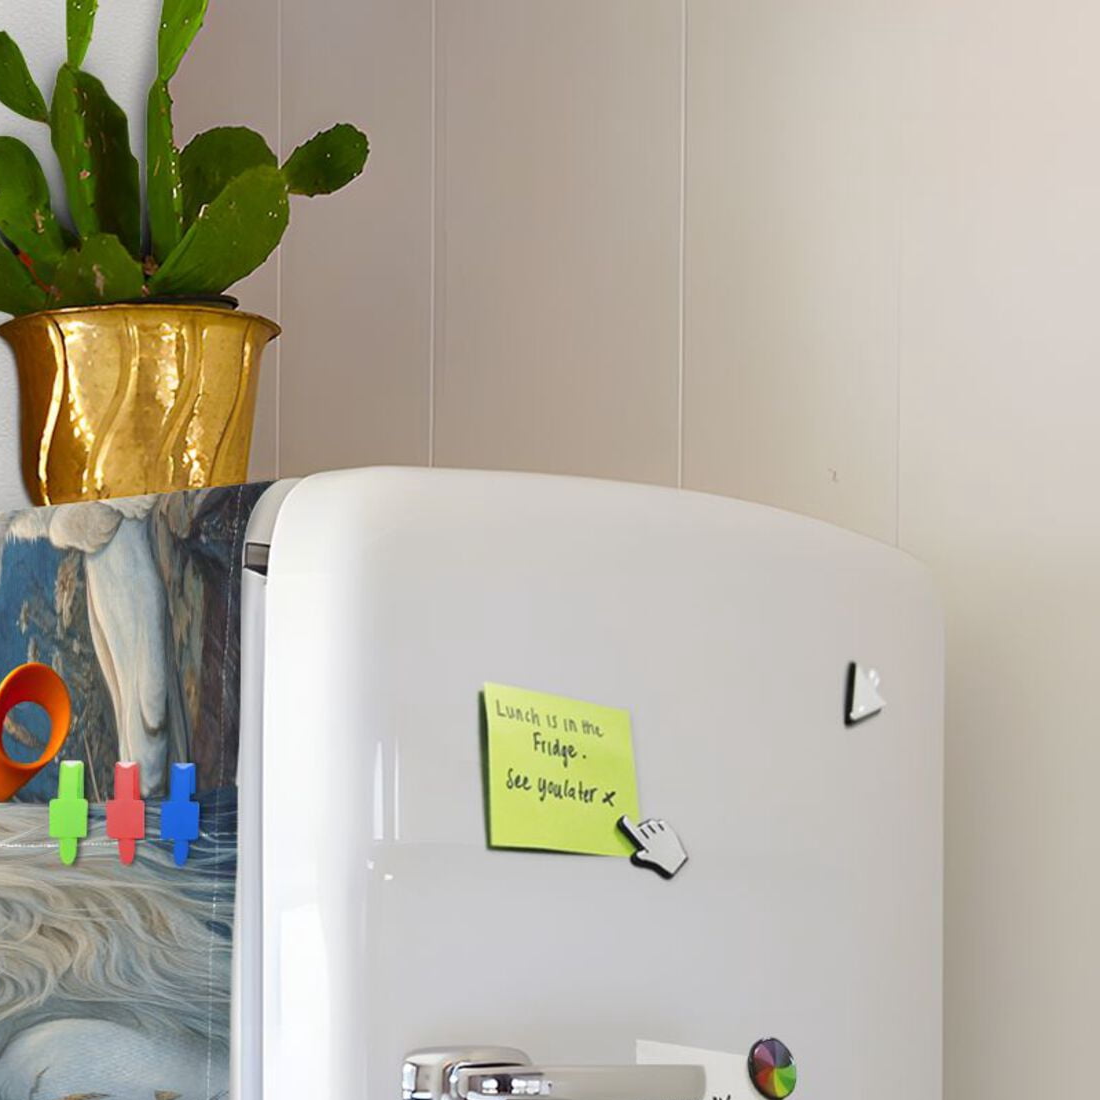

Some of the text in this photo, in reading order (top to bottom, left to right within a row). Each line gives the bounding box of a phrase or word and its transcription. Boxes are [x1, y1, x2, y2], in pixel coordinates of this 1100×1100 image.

[495, 698, 541, 727] Lunch
[563, 718, 578, 733] in
[581, 720, 604, 738] the
[506, 767, 532, 790] See
